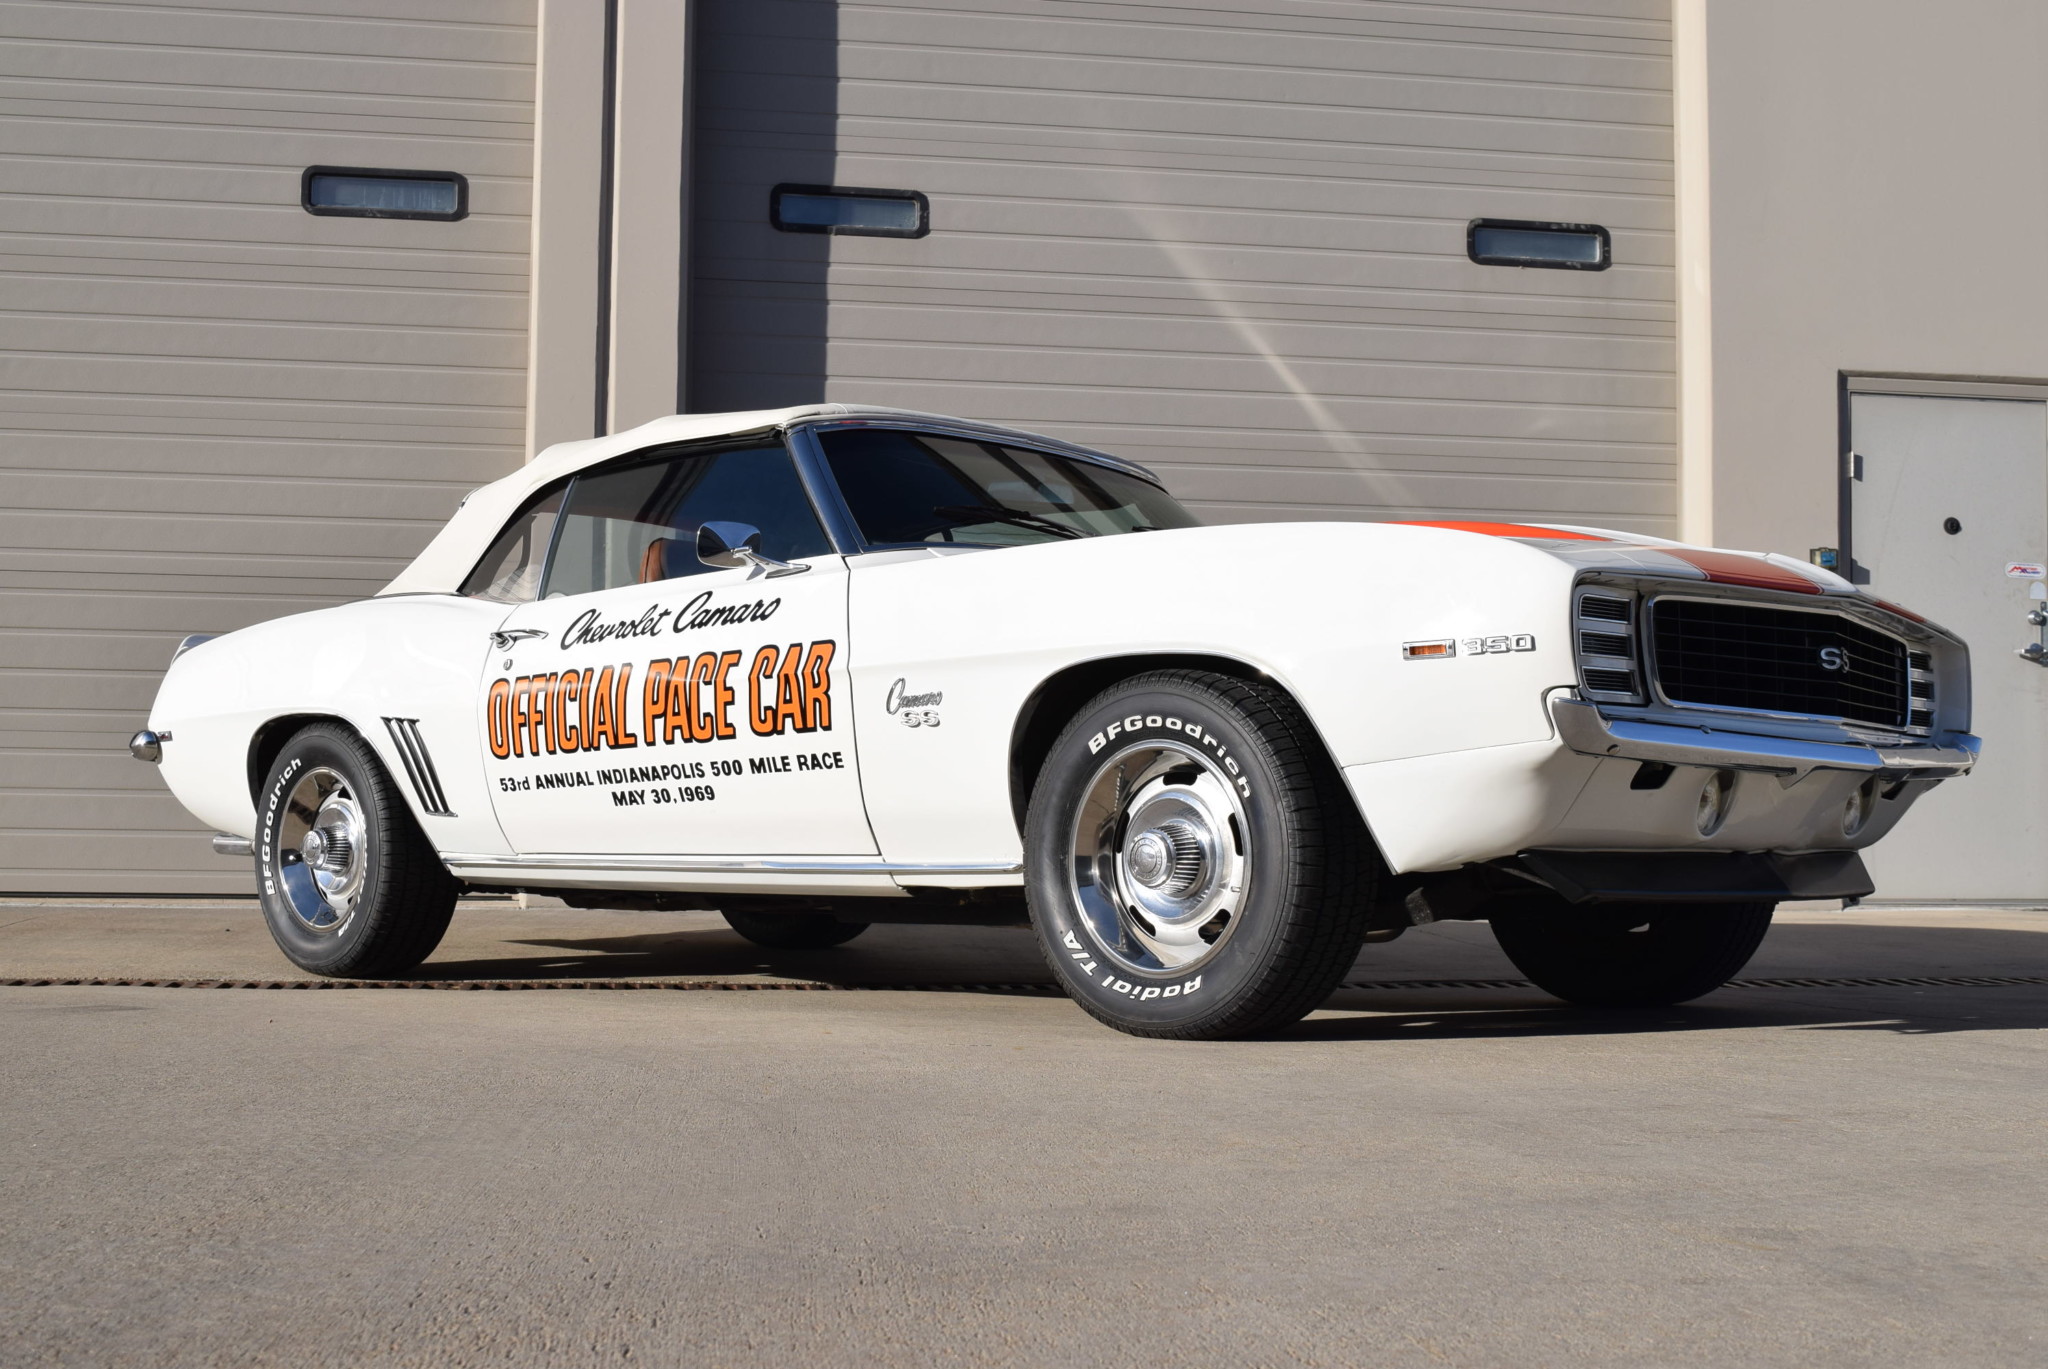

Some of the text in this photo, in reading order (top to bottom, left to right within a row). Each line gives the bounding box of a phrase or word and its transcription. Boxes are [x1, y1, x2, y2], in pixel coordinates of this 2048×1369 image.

[560, 591, 782, 650] Chevrolet Camaro
[1462, 634, 1536, 656] 350
[1820, 646, 1850, 674] SS
[487, 639, 836, 760] OFFICIAL PACE CAR
[900, 709, 941, 728] SS
[499, 751, 845, 792] 53rd ANNUAL INDIANAPOLIS 500 MILE RACE
[1087, 714, 1252, 799] BFGoodrich
[611, 790, 646, 806] MAY
[262, 758, 302, 896] BFGoodrich
[1062, 929, 1202, 1001] Radial T/A
